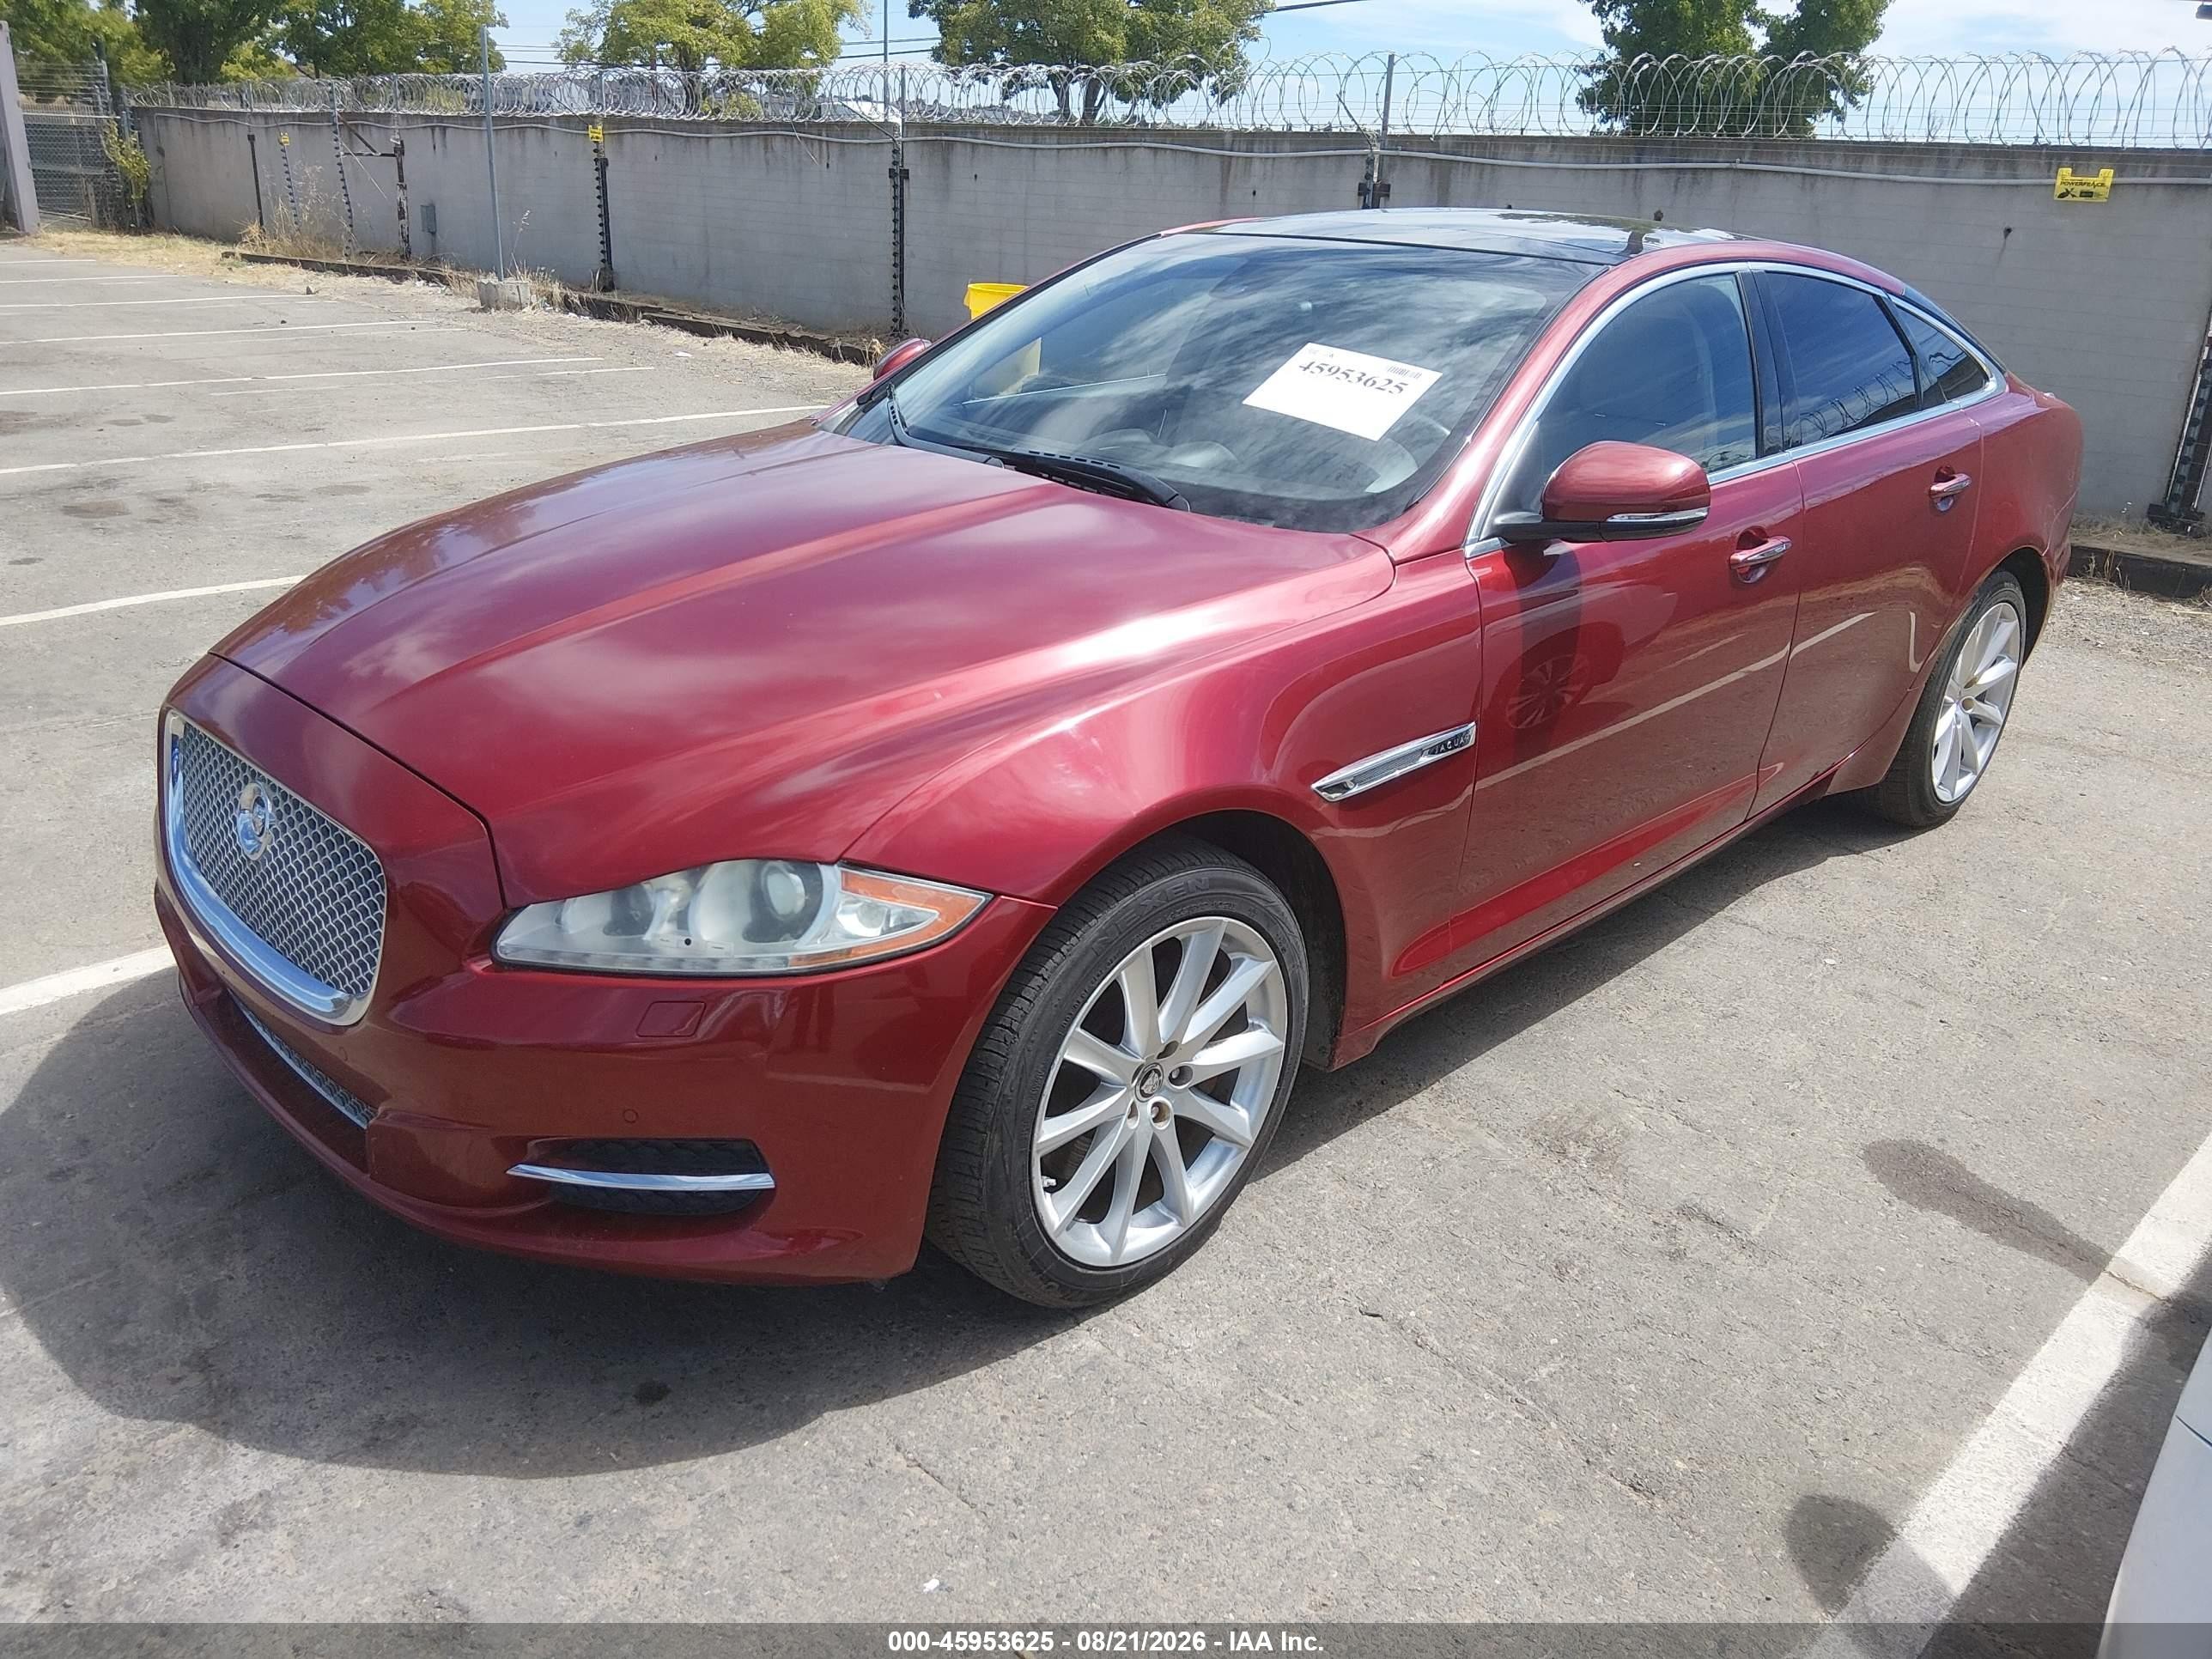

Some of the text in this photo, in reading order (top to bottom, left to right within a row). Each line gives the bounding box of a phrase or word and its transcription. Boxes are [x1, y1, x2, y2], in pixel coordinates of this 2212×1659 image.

[1298, 361, 1409, 395] 45953625
[1435, 733, 1471, 754] JAGUAR
[1091, 877, 1210, 957] NEXEN
